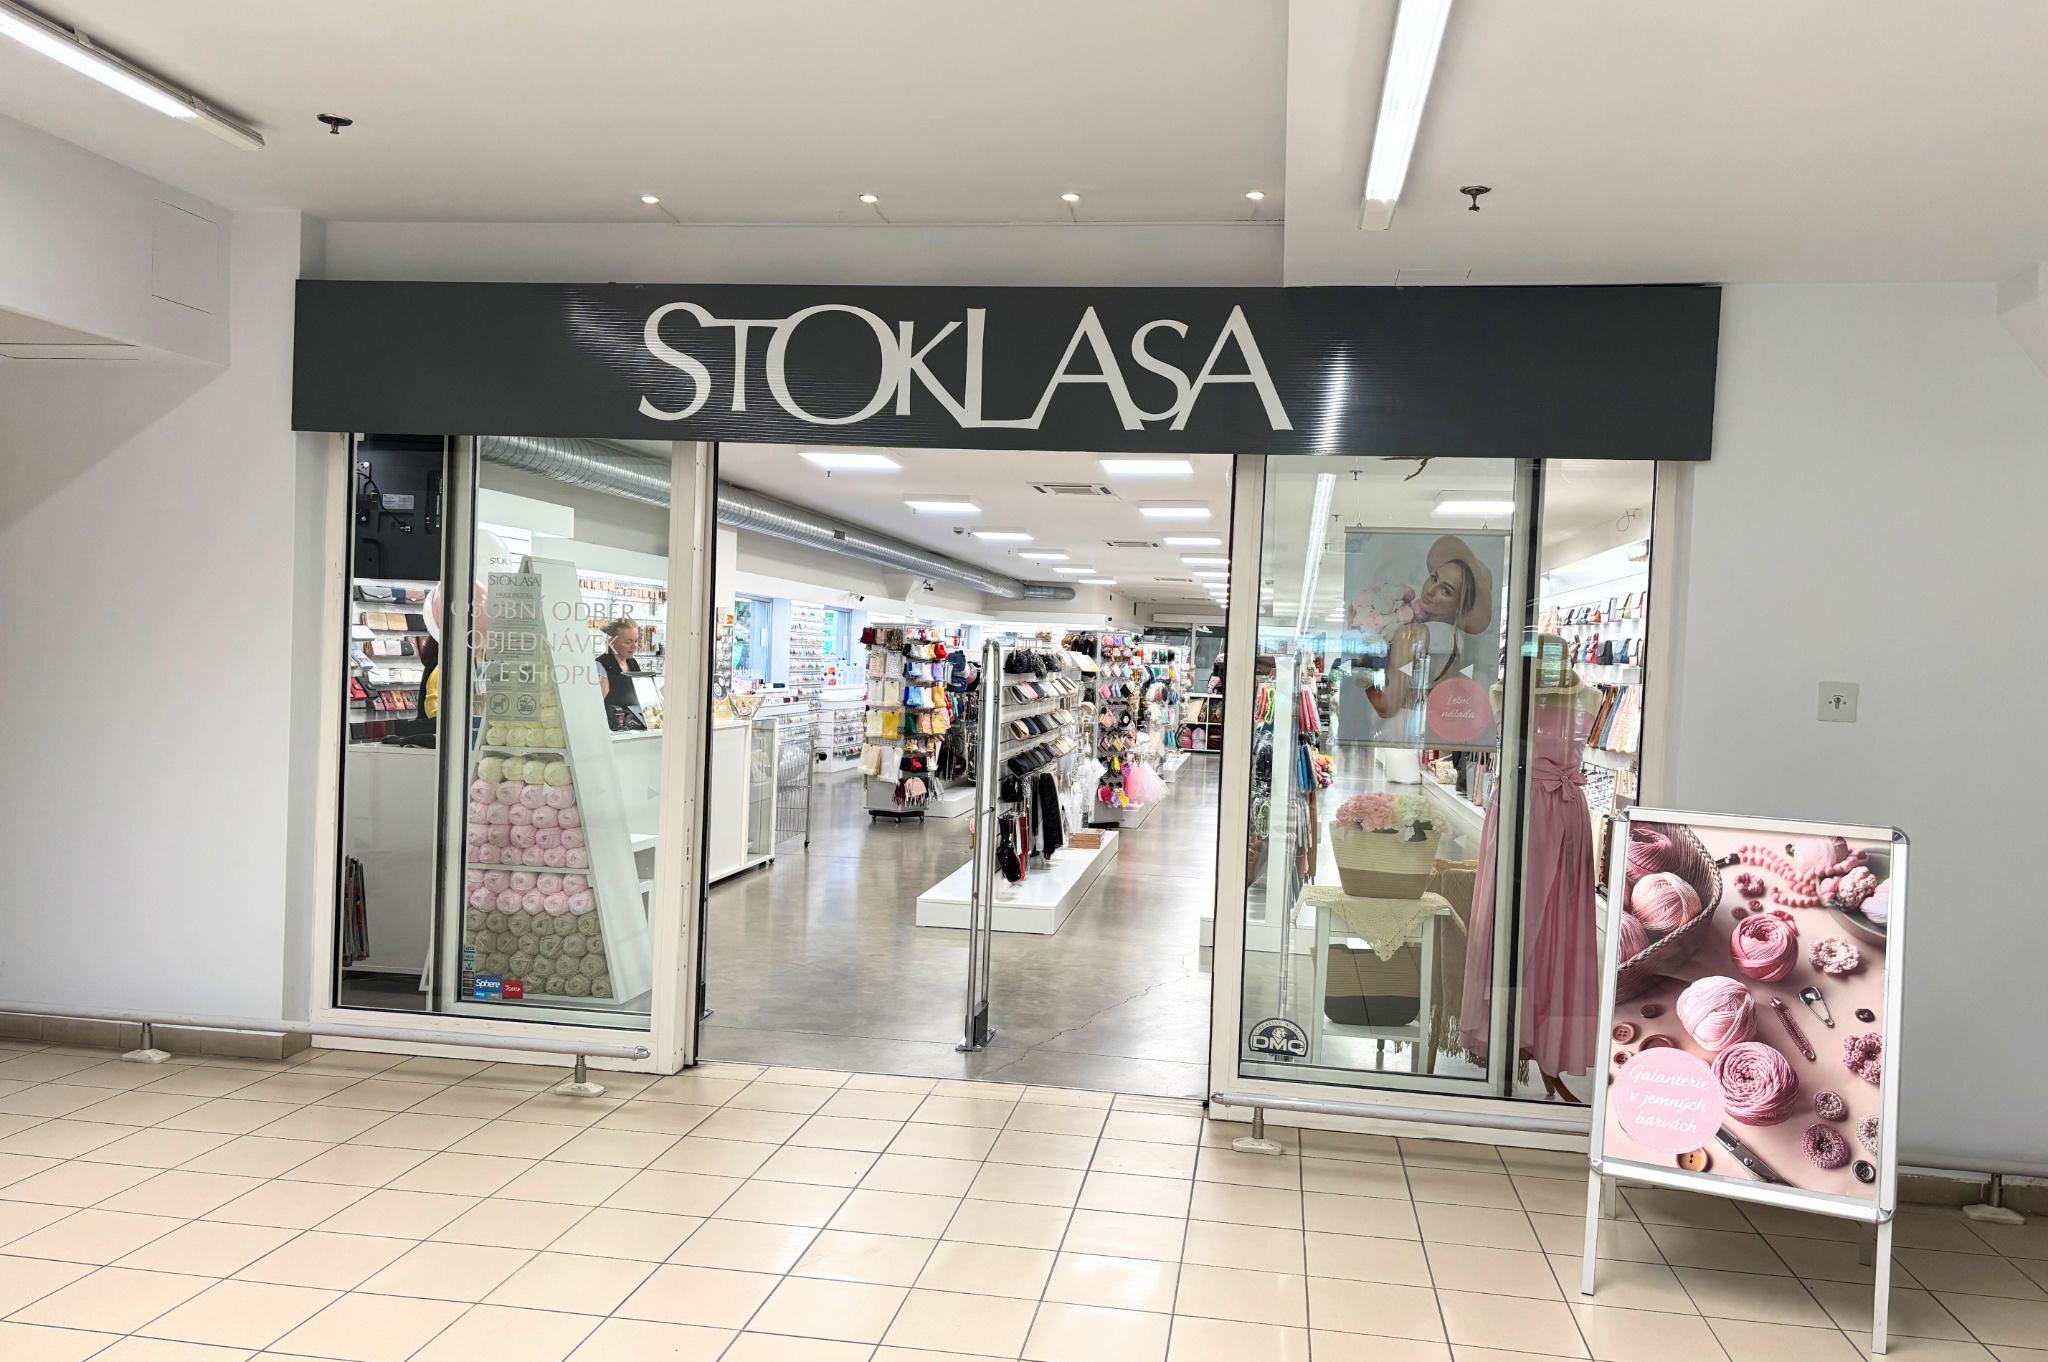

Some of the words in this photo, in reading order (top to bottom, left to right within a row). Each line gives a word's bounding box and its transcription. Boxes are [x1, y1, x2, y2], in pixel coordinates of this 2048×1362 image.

[638, 301, 1294, 431] STOKLASA
[488, 575, 541, 587] STOKLASA
[552, 599, 634, 623] ODBĚR
[467, 628, 619, 655] OBJEDNÁVEK
[500, 662, 600, 686] E-SHOPU
[1252, 1035, 1305, 1054] DMC
[1629, 1064, 1709, 1089] Galanterie
[1640, 1091, 1707, 1113] jemných
[1635, 1112, 1697, 1133] barvách
